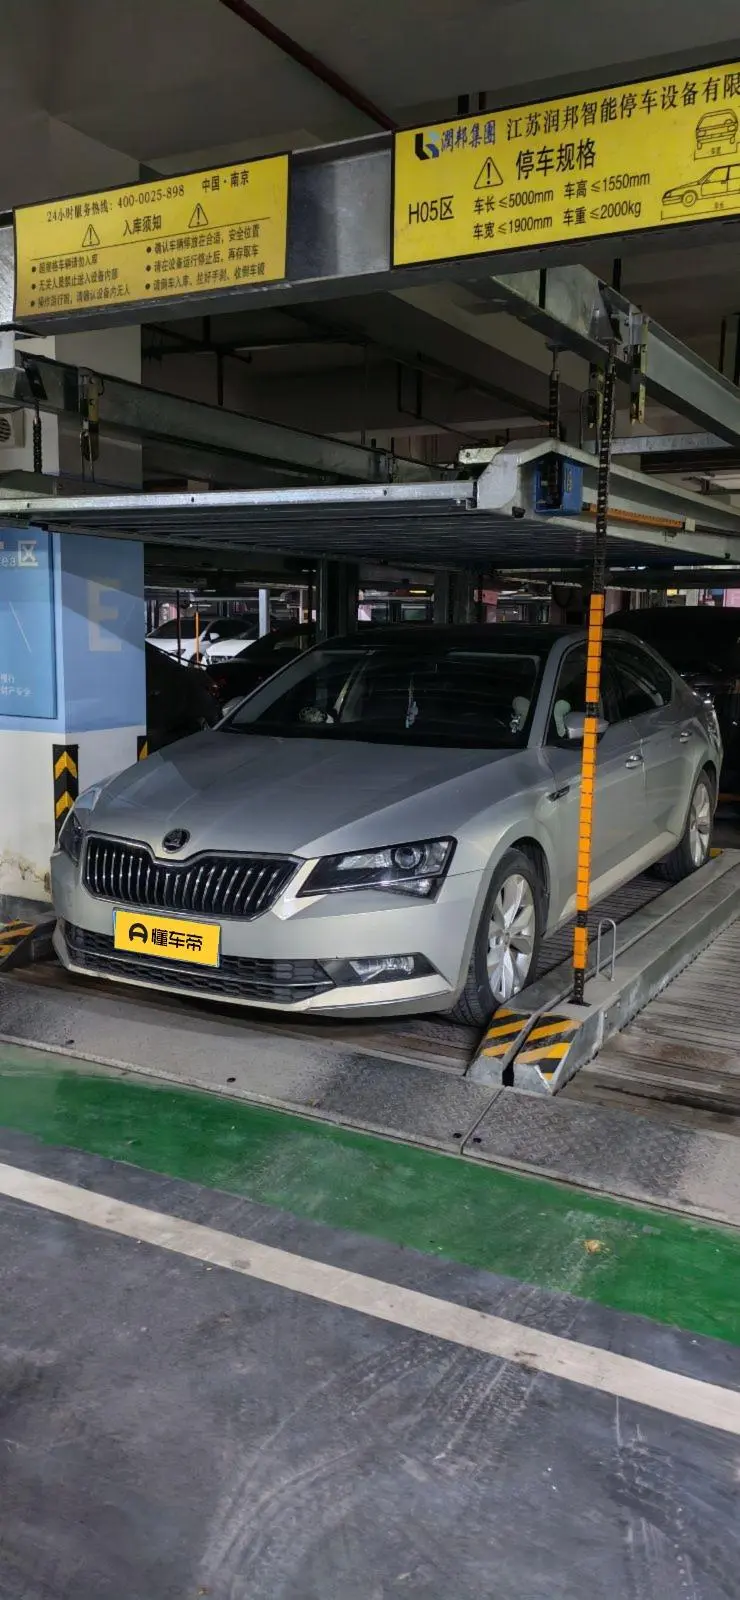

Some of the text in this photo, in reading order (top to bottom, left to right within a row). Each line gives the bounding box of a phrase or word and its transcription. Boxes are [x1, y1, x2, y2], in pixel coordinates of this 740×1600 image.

[515, 138, 597, 181] 停车规格
[408, 195, 455, 225] H05区
[122, 214, 162, 237] 入库须知
